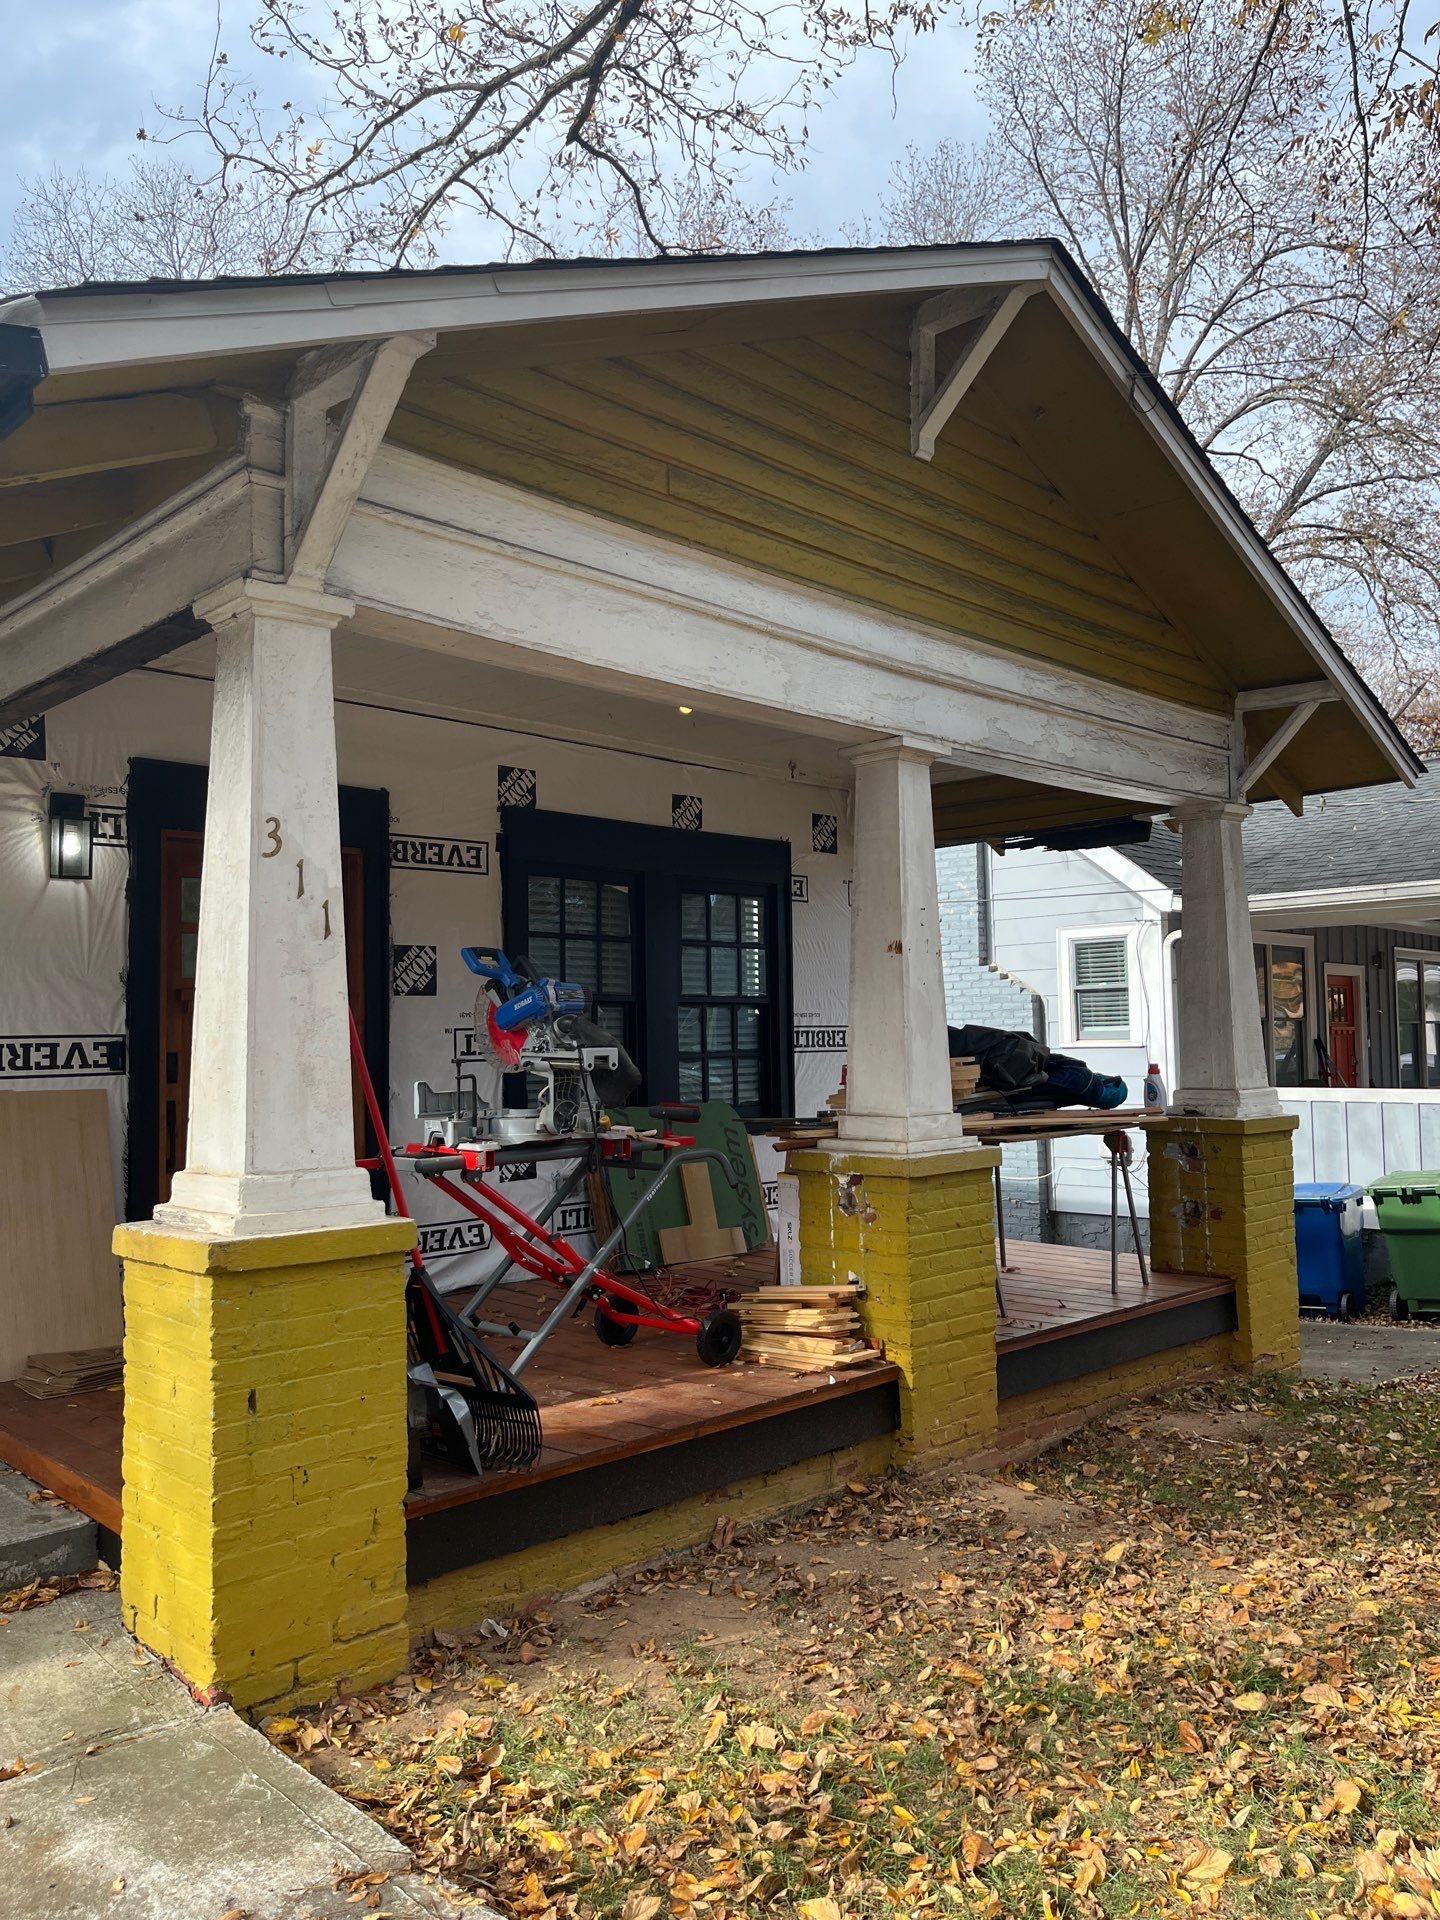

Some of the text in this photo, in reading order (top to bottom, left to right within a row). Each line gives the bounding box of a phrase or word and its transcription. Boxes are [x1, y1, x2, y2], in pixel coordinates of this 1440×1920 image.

[393, 945, 422, 978] DEPOT
[393, 945, 437, 996] HOME
[416, 971, 434, 991] THE
[0, 1042, 113, 1071] EVER
